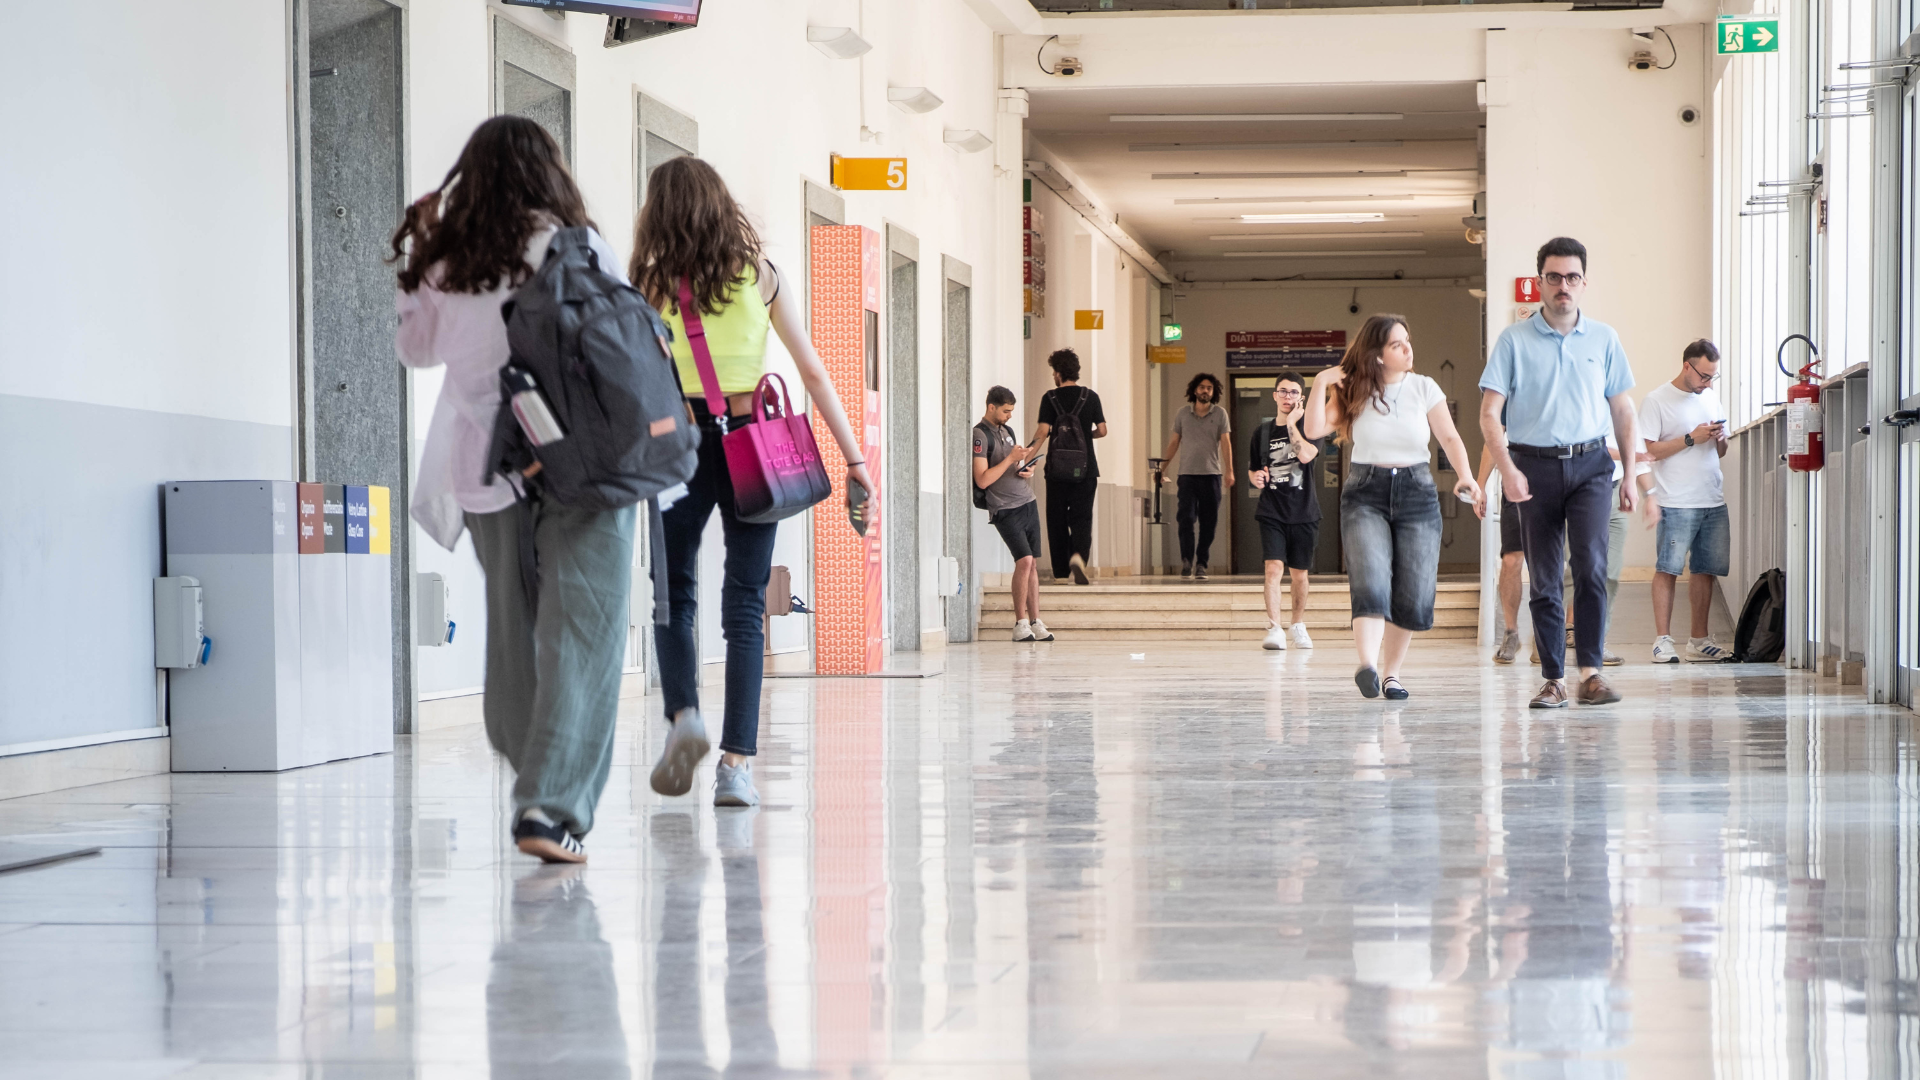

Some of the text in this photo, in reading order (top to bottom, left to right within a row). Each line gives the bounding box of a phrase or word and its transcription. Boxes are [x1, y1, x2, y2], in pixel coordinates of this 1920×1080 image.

[886, 161, 905, 188] 5
[1091, 312, 1102, 328] 7
[1230, 334, 1255, 343] DIATI
[774, 440, 796, 454] THE
[766, 451, 815, 469] TOTE BAG
